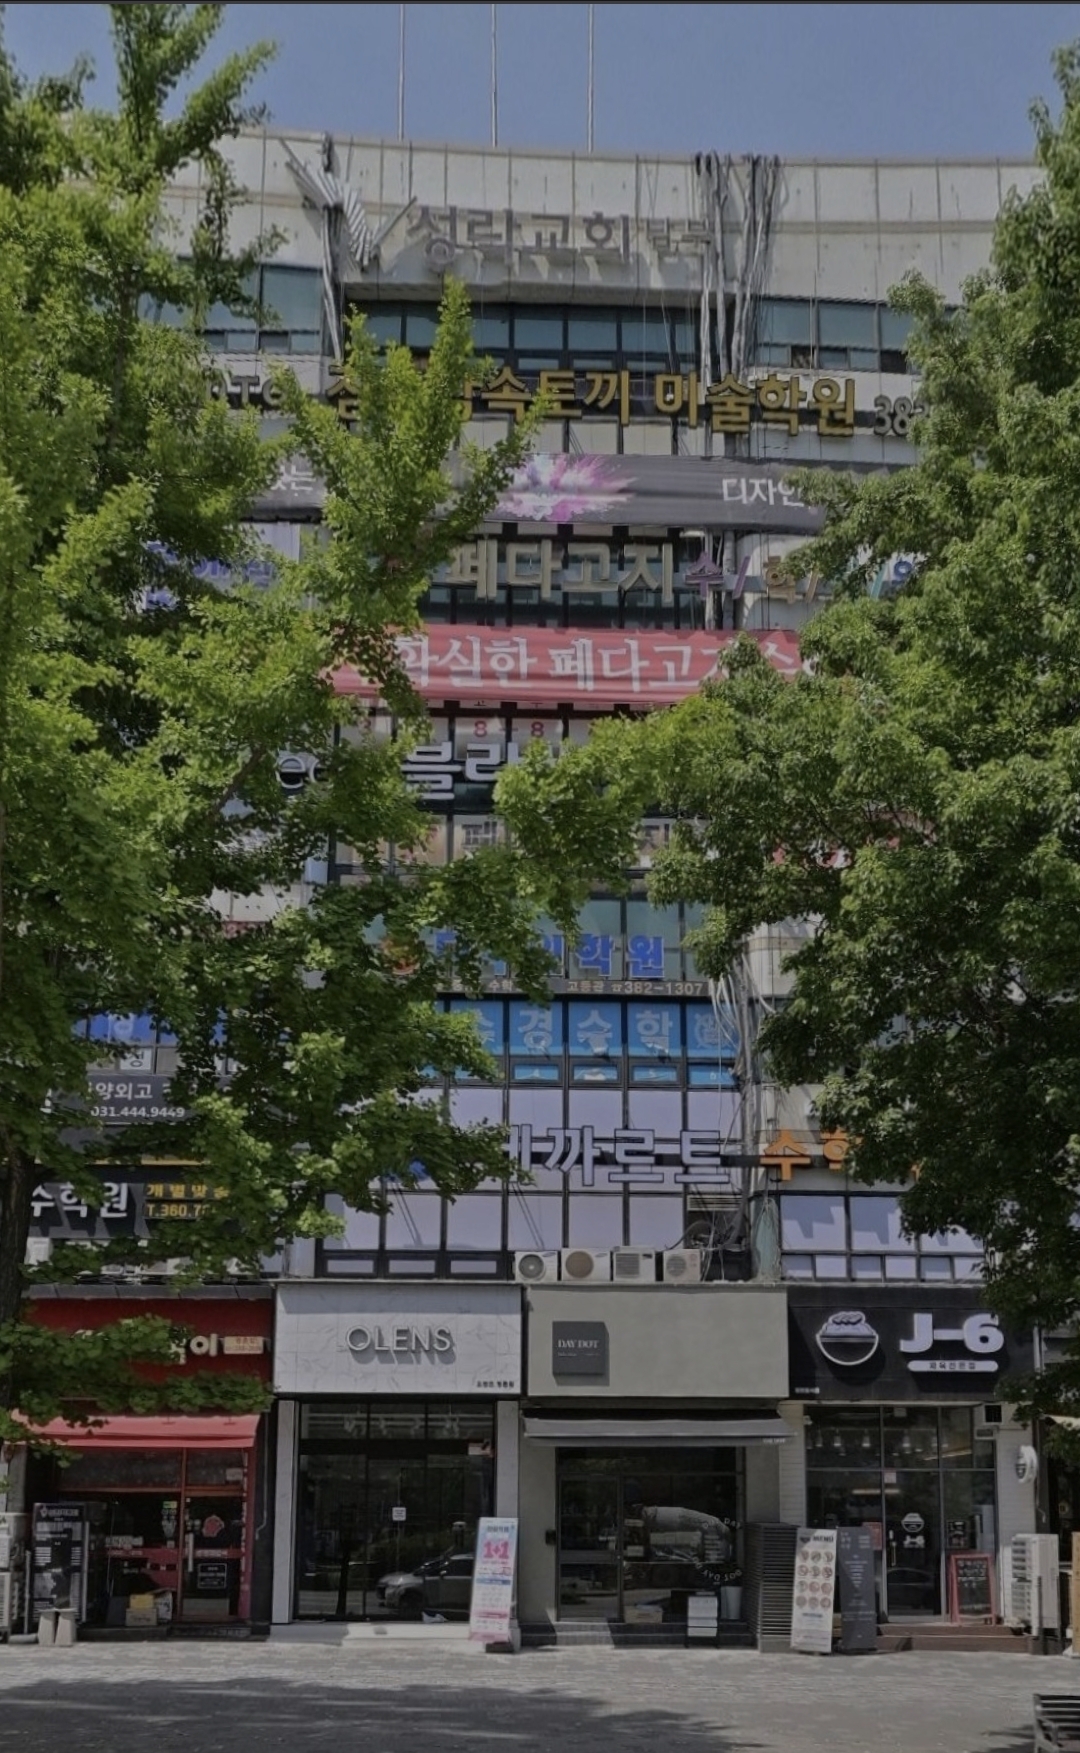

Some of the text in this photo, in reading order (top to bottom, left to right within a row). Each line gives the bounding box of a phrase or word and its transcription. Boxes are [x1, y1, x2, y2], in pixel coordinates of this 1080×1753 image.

[654, 370, 856, 437] 미술학원
[445, 537, 675, 608] 페다고지
[346, 1325, 451, 1351] OLENS
[899, 1312, 1005, 1354] J-6
